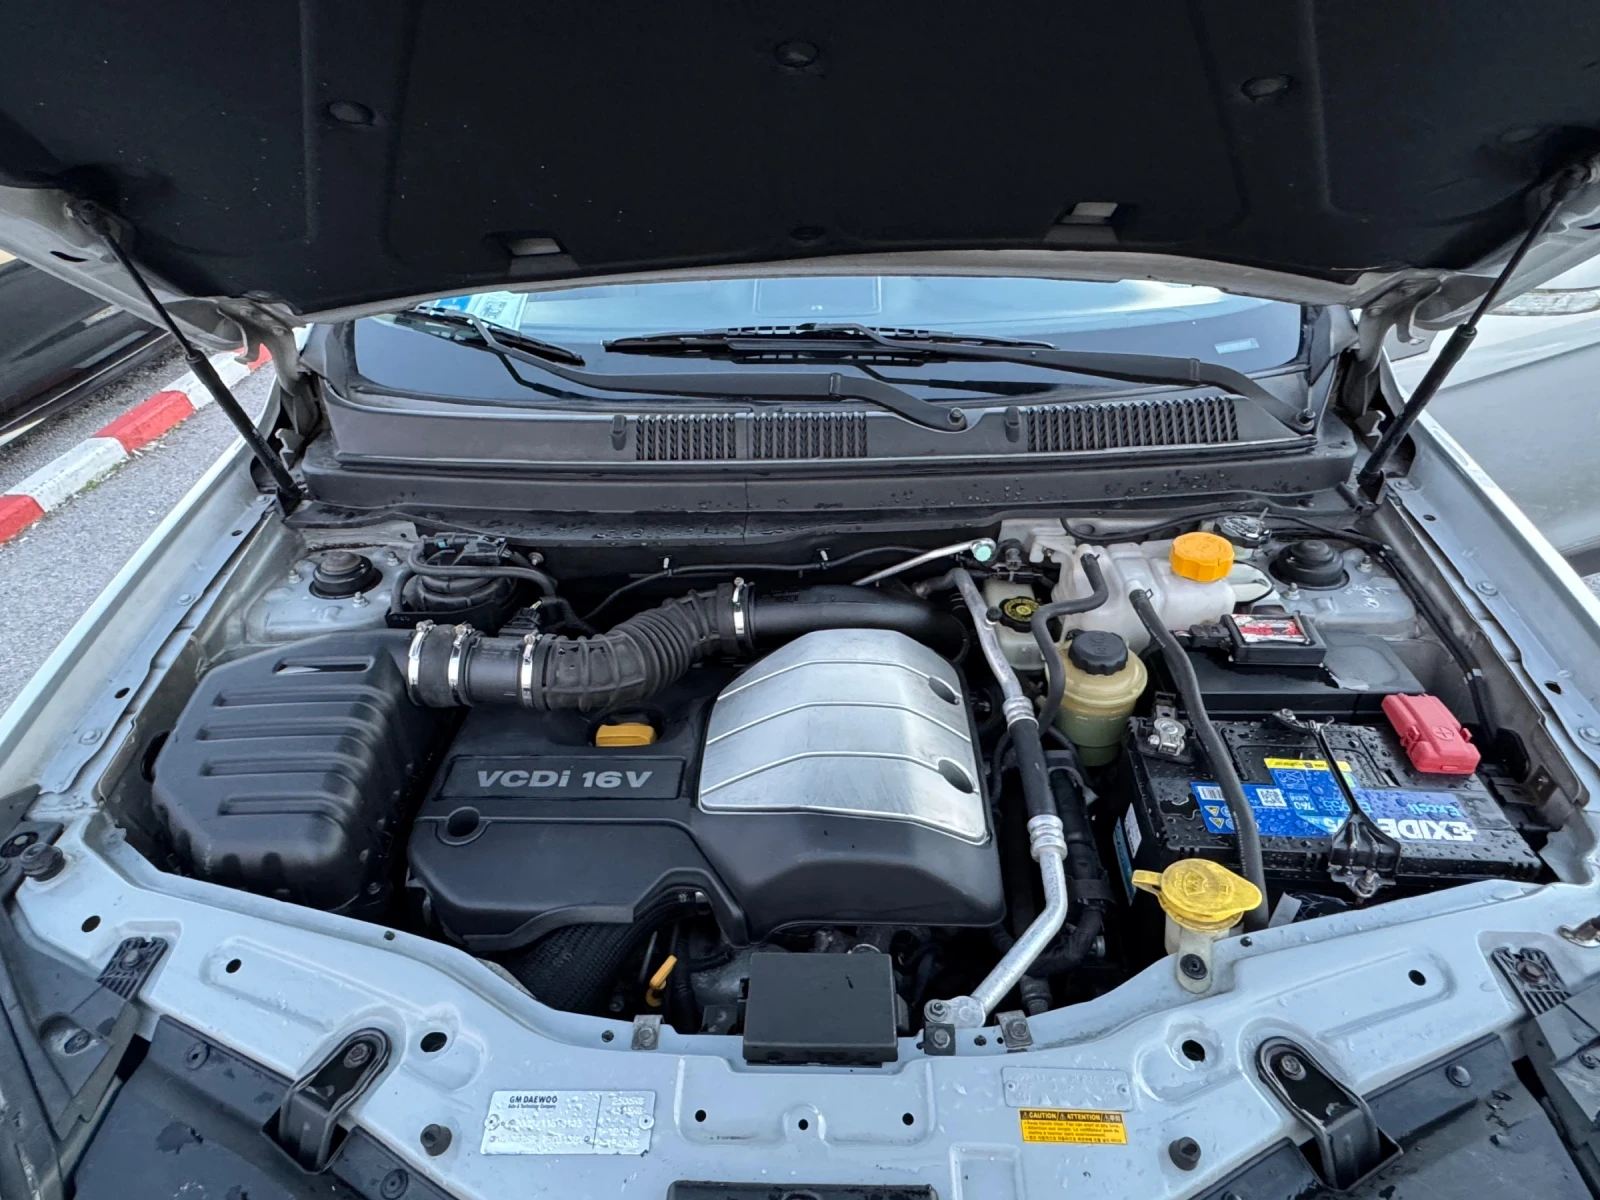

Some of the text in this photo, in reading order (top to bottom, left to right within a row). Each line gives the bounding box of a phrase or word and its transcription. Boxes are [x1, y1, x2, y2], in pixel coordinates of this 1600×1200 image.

[477, 770, 652, 788] VCDi 16V
[1293, 801, 1315, 811] 760
[1322, 800, 1373, 812] E955
[1377, 818, 1476, 841] EXIDE
[509, 1095, 558, 1104] GM DAEWOO
[1028, 1111, 1057, 1119] CAUTION
